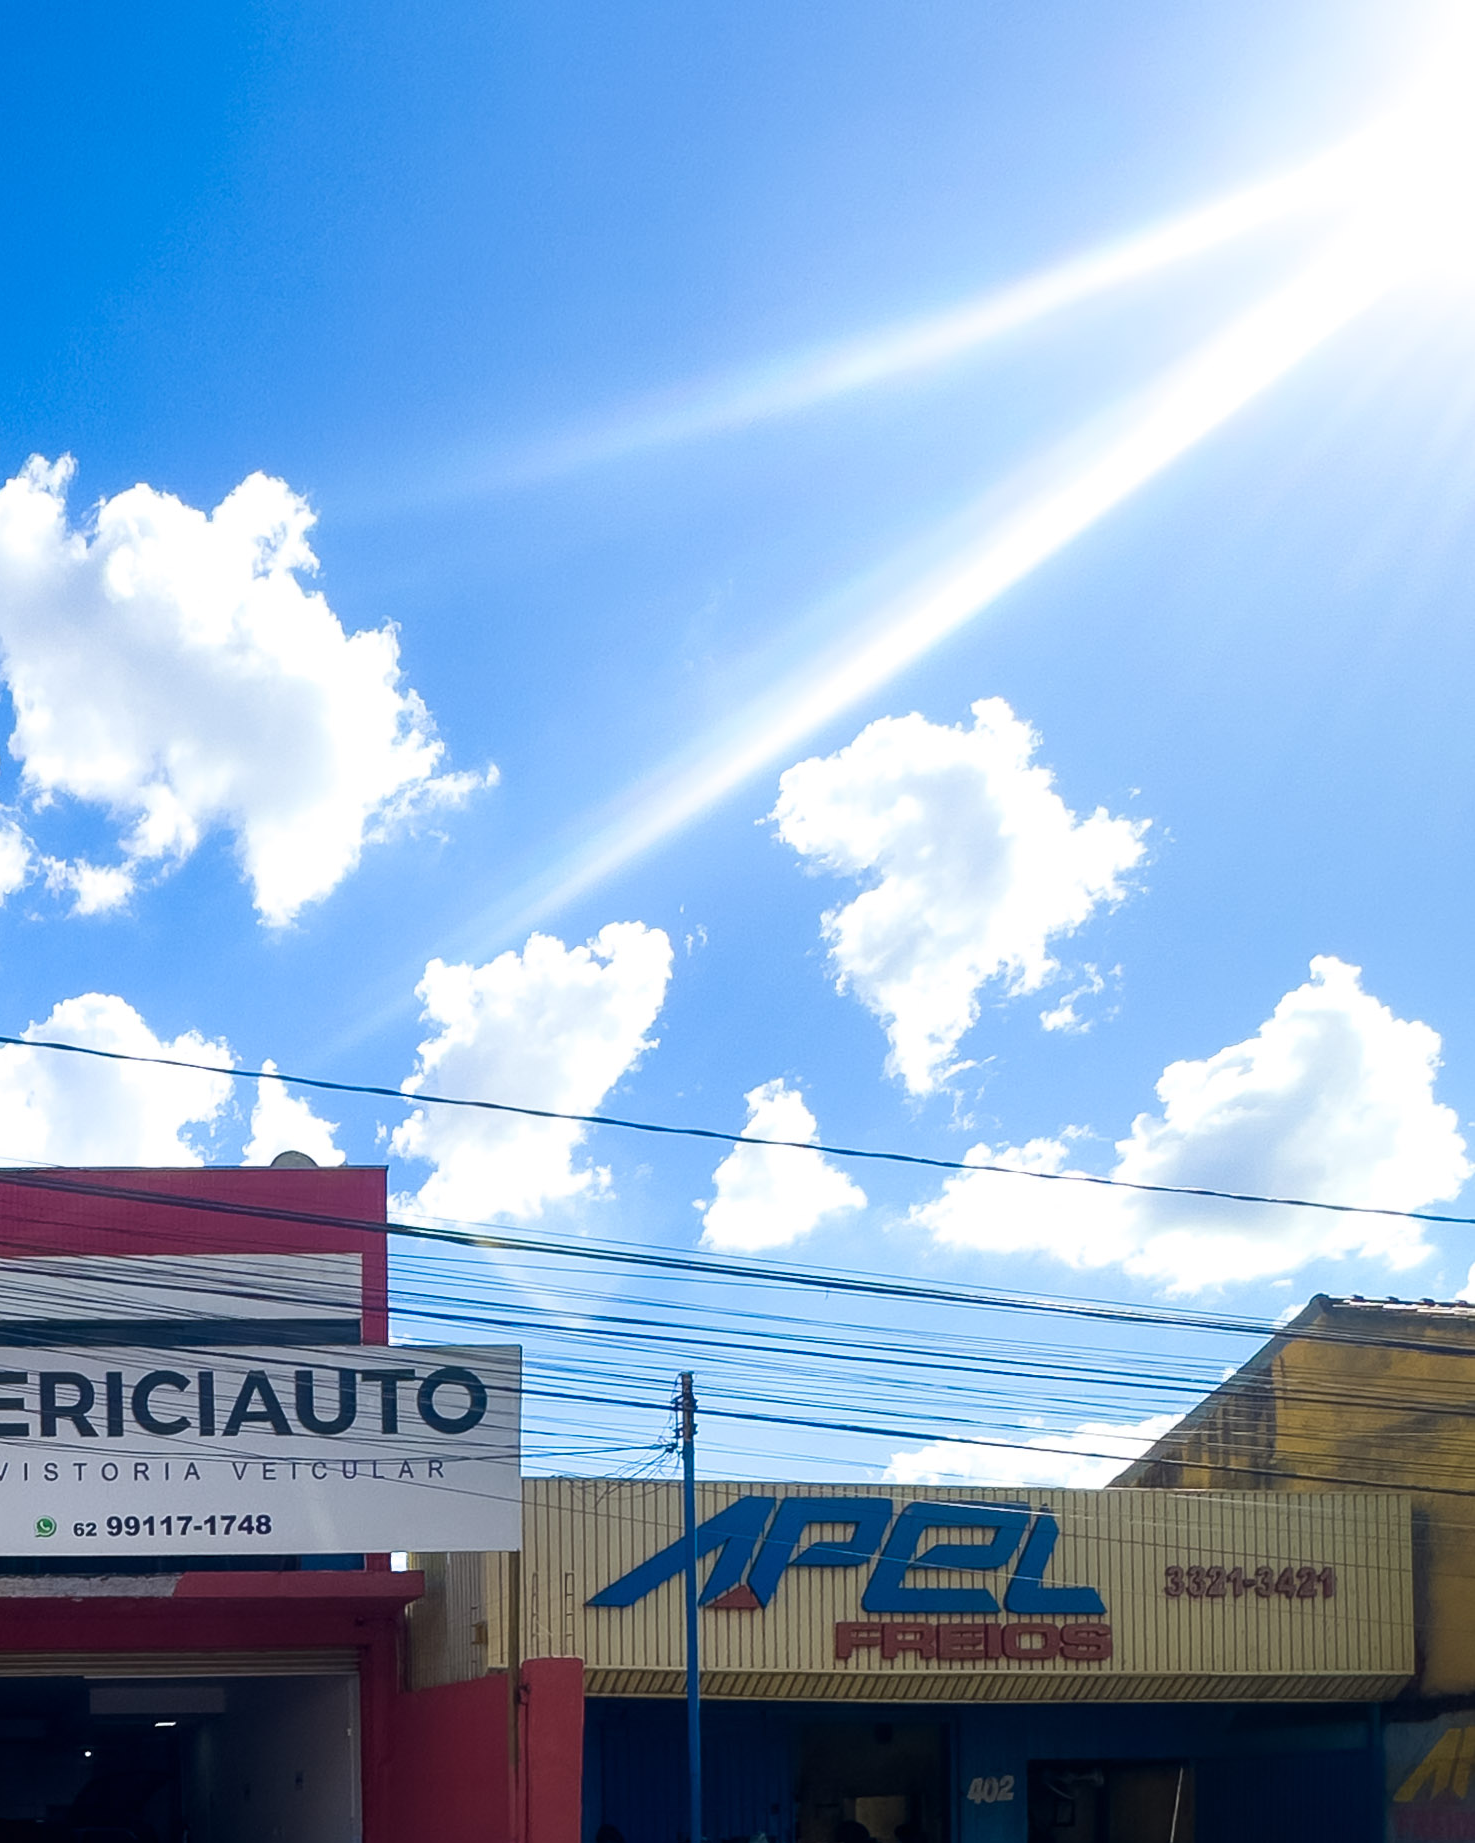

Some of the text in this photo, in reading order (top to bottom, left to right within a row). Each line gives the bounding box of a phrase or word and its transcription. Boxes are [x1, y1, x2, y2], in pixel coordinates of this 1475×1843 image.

[232, 1460, 445, 1481] VEICULAR
[72, 1515, 272, 1537] 62 99117-1748
[1164, 1565, 1336, 1599] 3321-3421
[835, 1621, 1113, 1661] FREIOS
[966, 1774, 1015, 1805] 402
